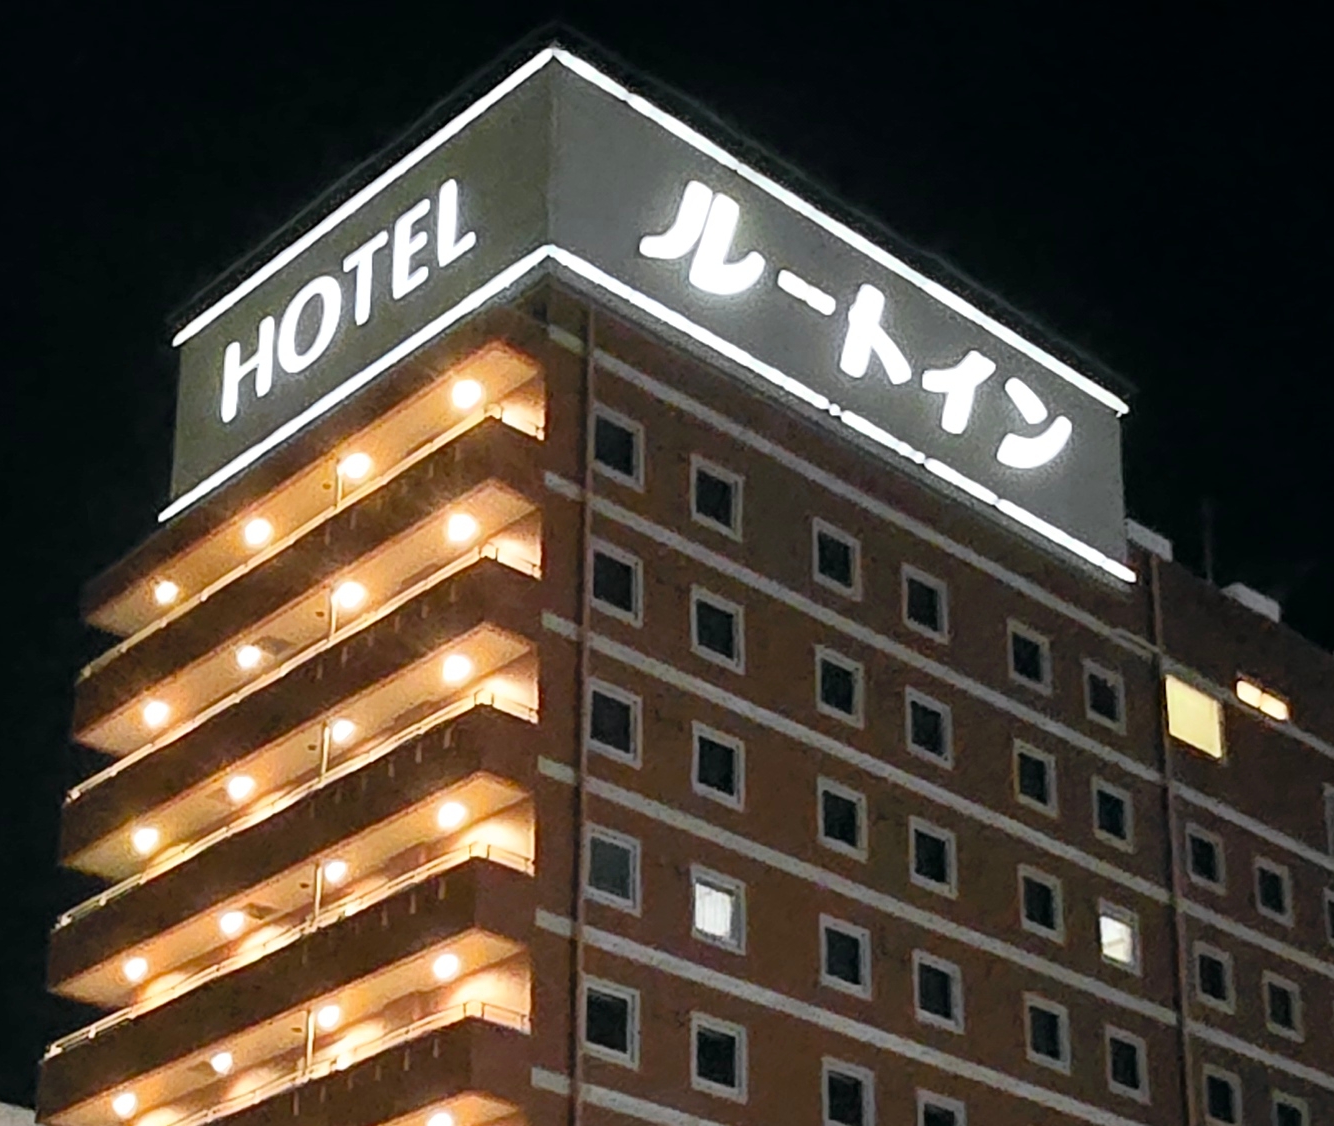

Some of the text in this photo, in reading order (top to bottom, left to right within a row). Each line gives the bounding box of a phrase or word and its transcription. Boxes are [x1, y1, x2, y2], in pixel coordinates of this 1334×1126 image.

[220, 178, 476, 422] HOTEL
[639, 180, 1072, 469] ルートイン
